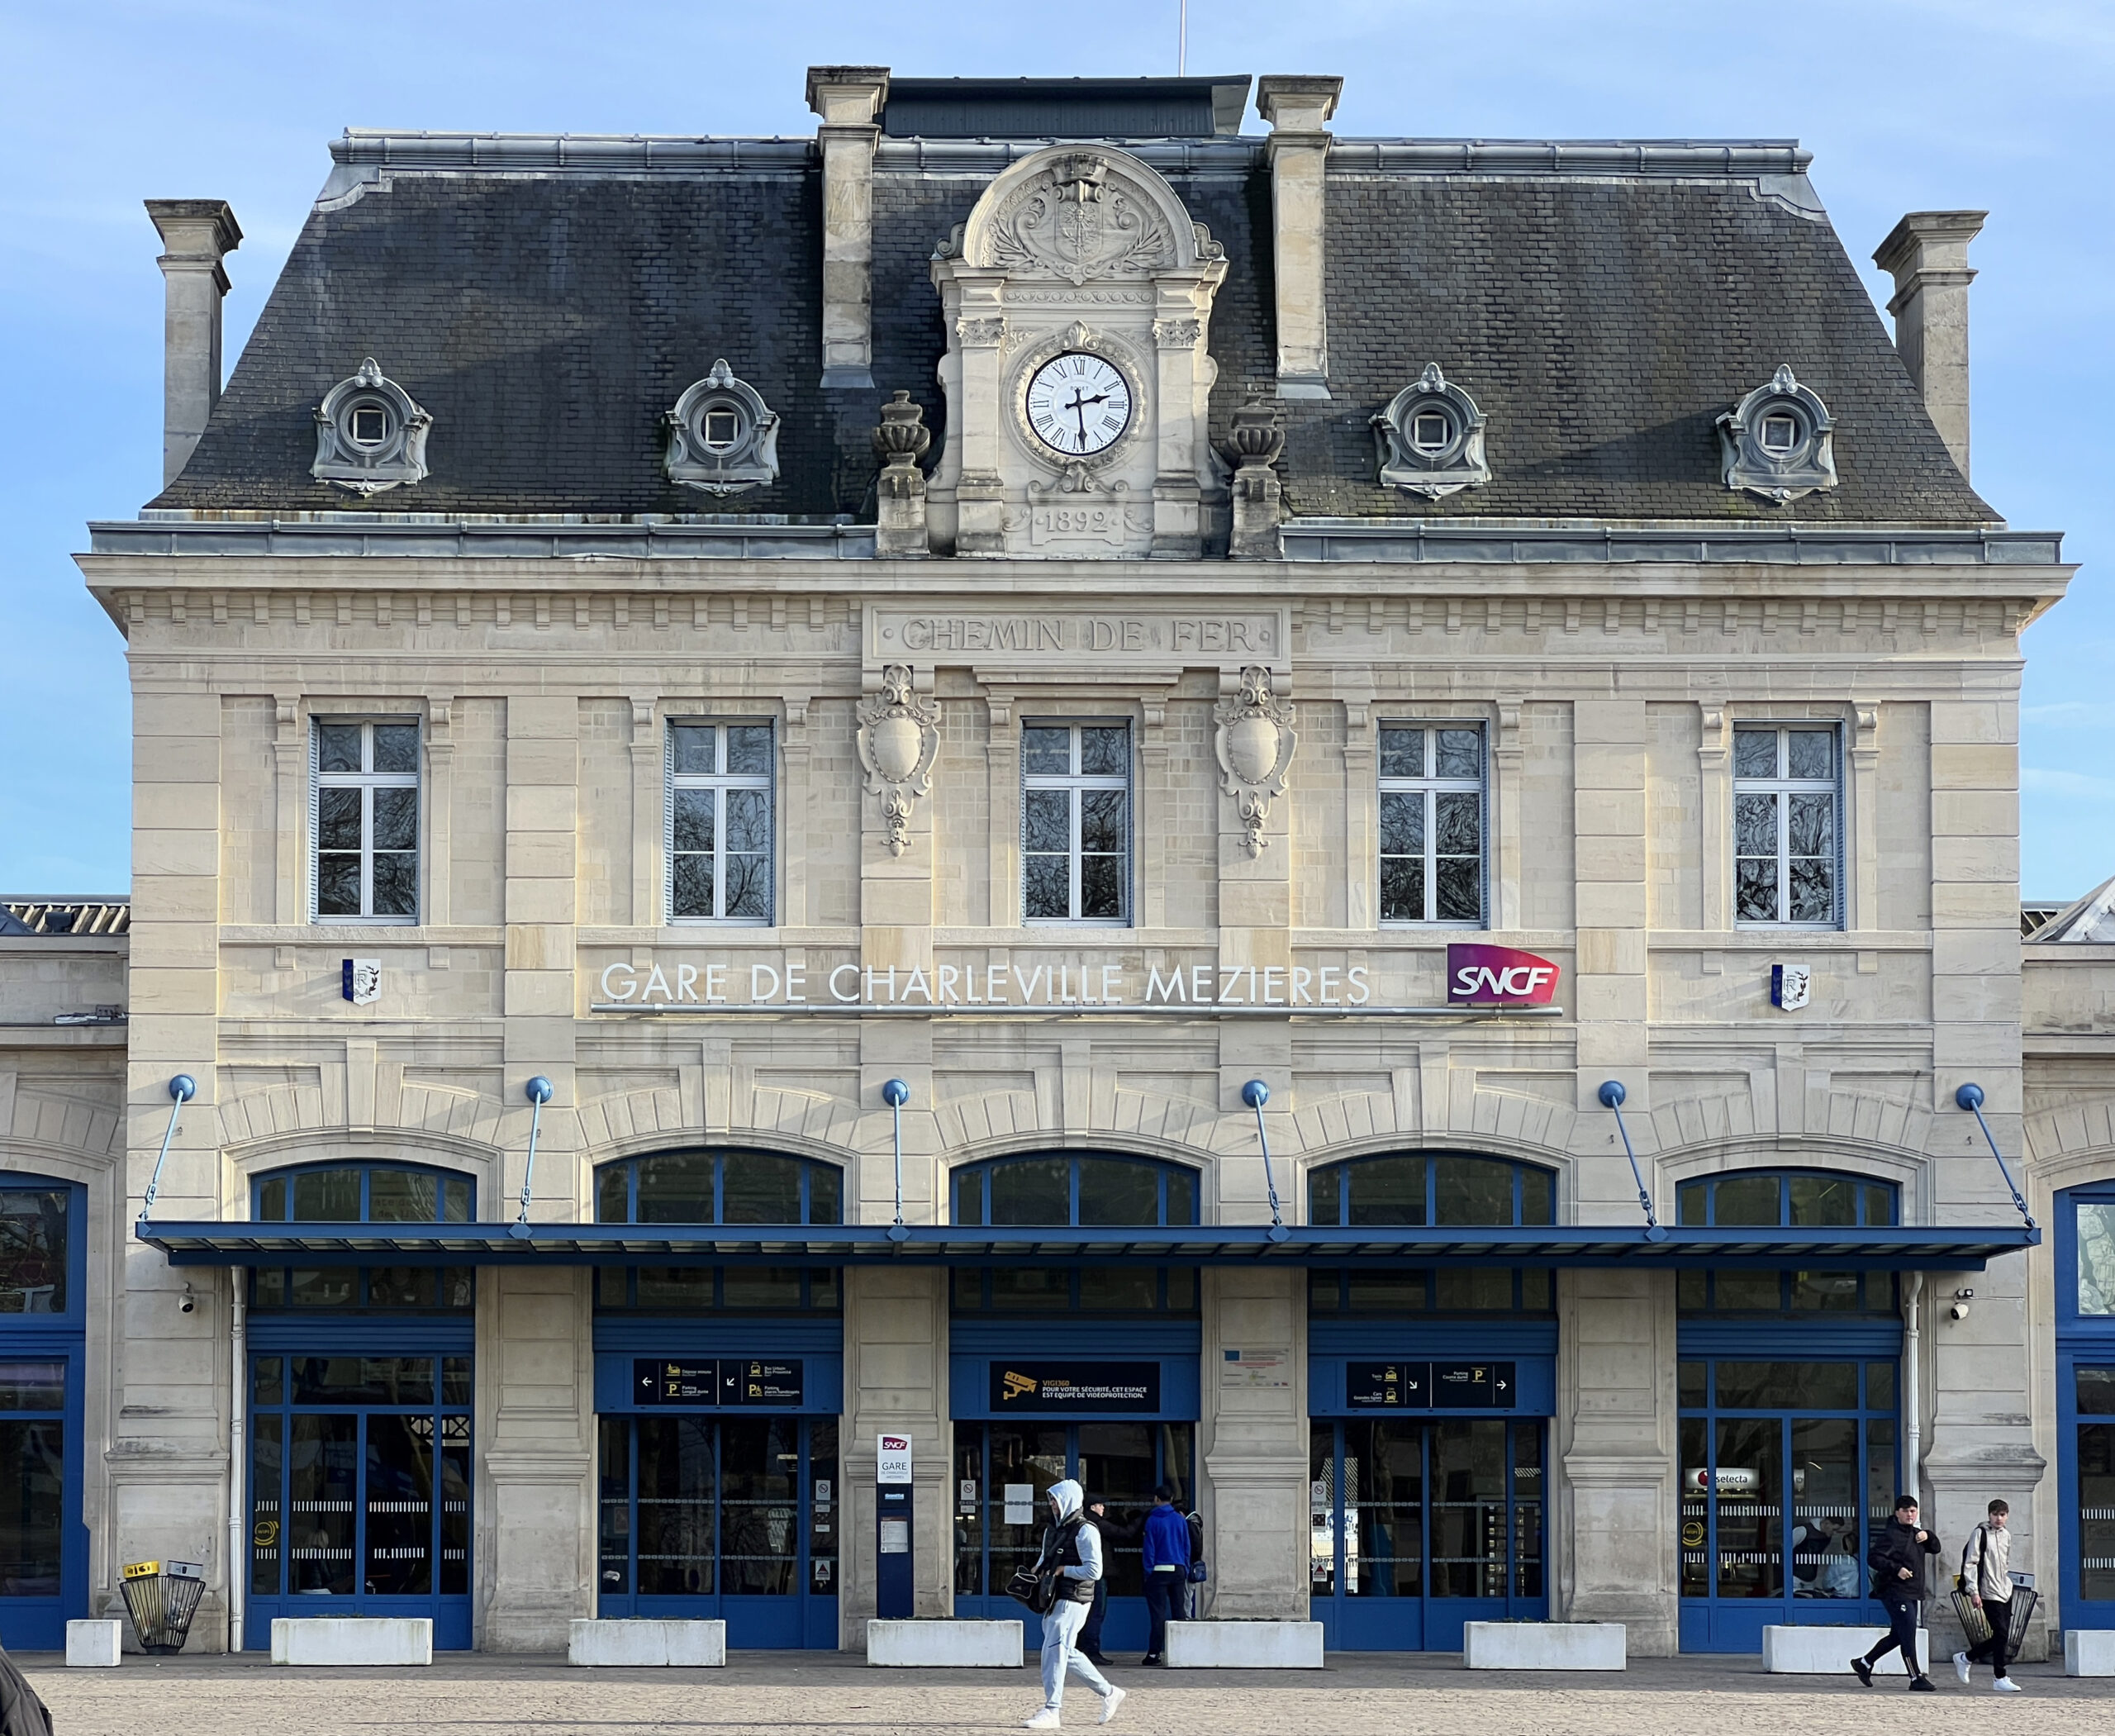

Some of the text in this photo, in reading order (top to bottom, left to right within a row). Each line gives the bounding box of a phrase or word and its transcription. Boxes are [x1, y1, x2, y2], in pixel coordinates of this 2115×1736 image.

[1045, 511, 1108, 532] 1892
[901, 619, 1257, 652] CHEMIN DE FER
[601, 963, 1370, 1005] GARE DE CHARLEVILLE MEZIERES
[1452, 966, 1553, 996] SNCF
[882, 1462, 907, 1471] GARE
[1716, 1475, 1748, 1483] selecta
